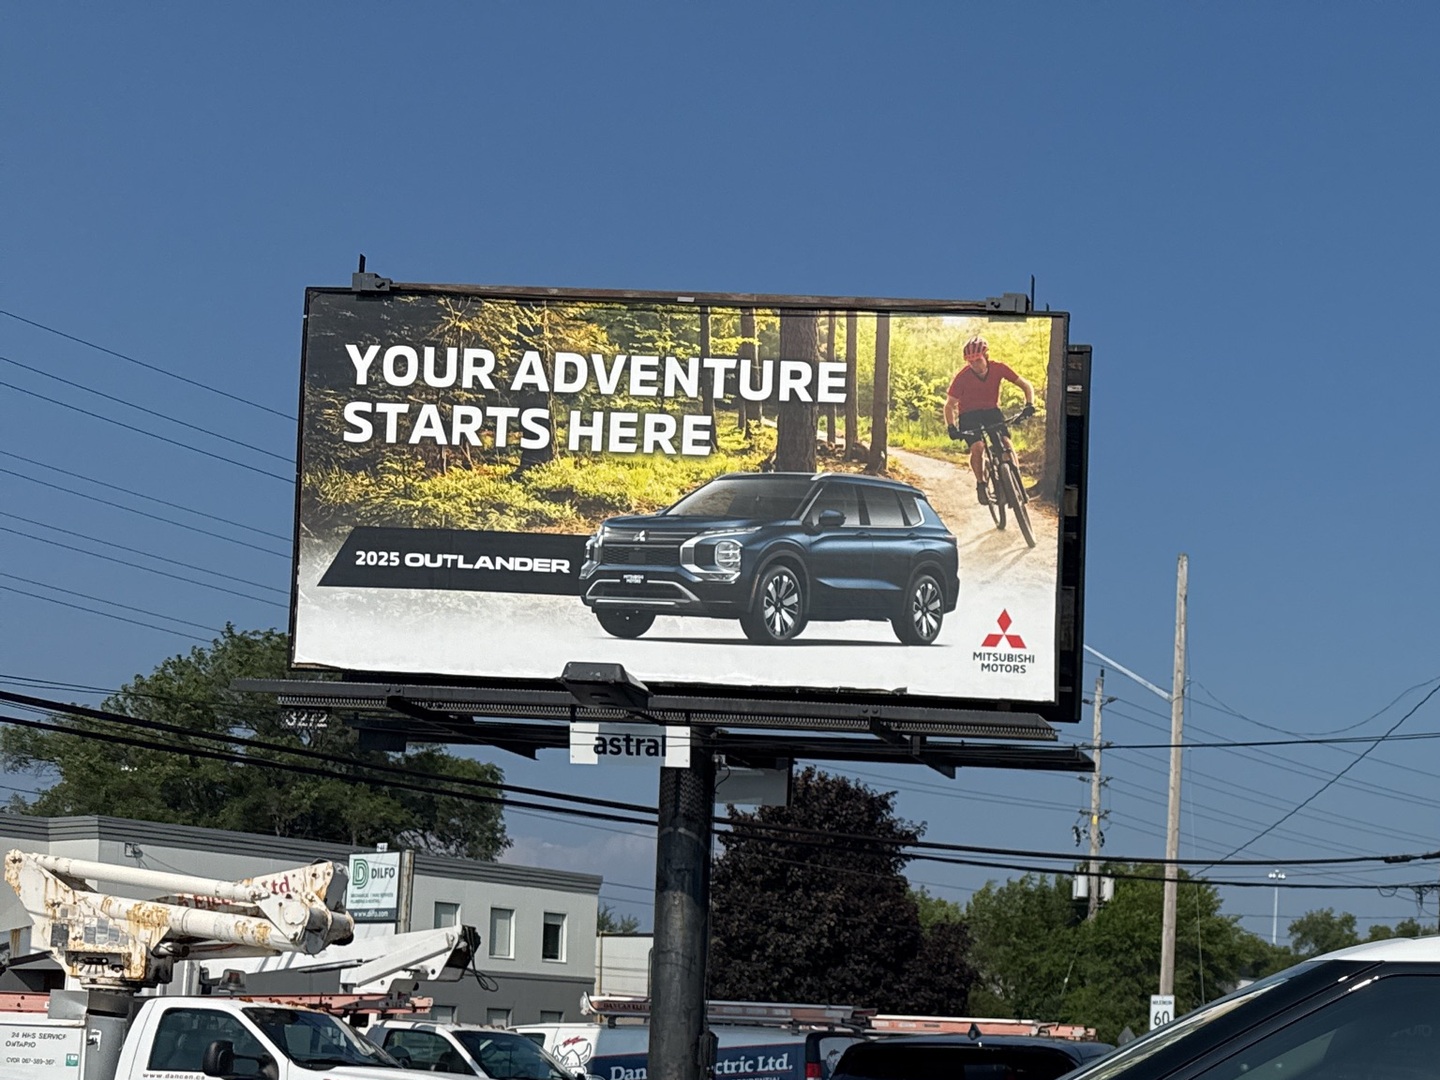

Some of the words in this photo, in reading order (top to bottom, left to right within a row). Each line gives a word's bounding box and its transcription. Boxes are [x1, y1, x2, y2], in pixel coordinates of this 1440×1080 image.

[345, 343, 496, 390] YOUR
[510, 350, 849, 404] ADVENTURE
[343, 401, 550, 450] STARTS
[568, 410, 713, 456] HERE
[355, 550, 400, 567] 2025
[404, 552, 571, 574] OUTLANDER
[973, 651, 1035, 664] MITSUBISHI
[981, 663, 1026, 674] MOTORS
[285, 711, 328, 728] 3212
[593, 733, 667, 758] astral
[371, 867, 395, 880] DILFO
[1154, 1010, 1170, 1026] 60
[715, 1056, 754, 1075] ctric
[757, 1052, 793, 1072] Ltd.
